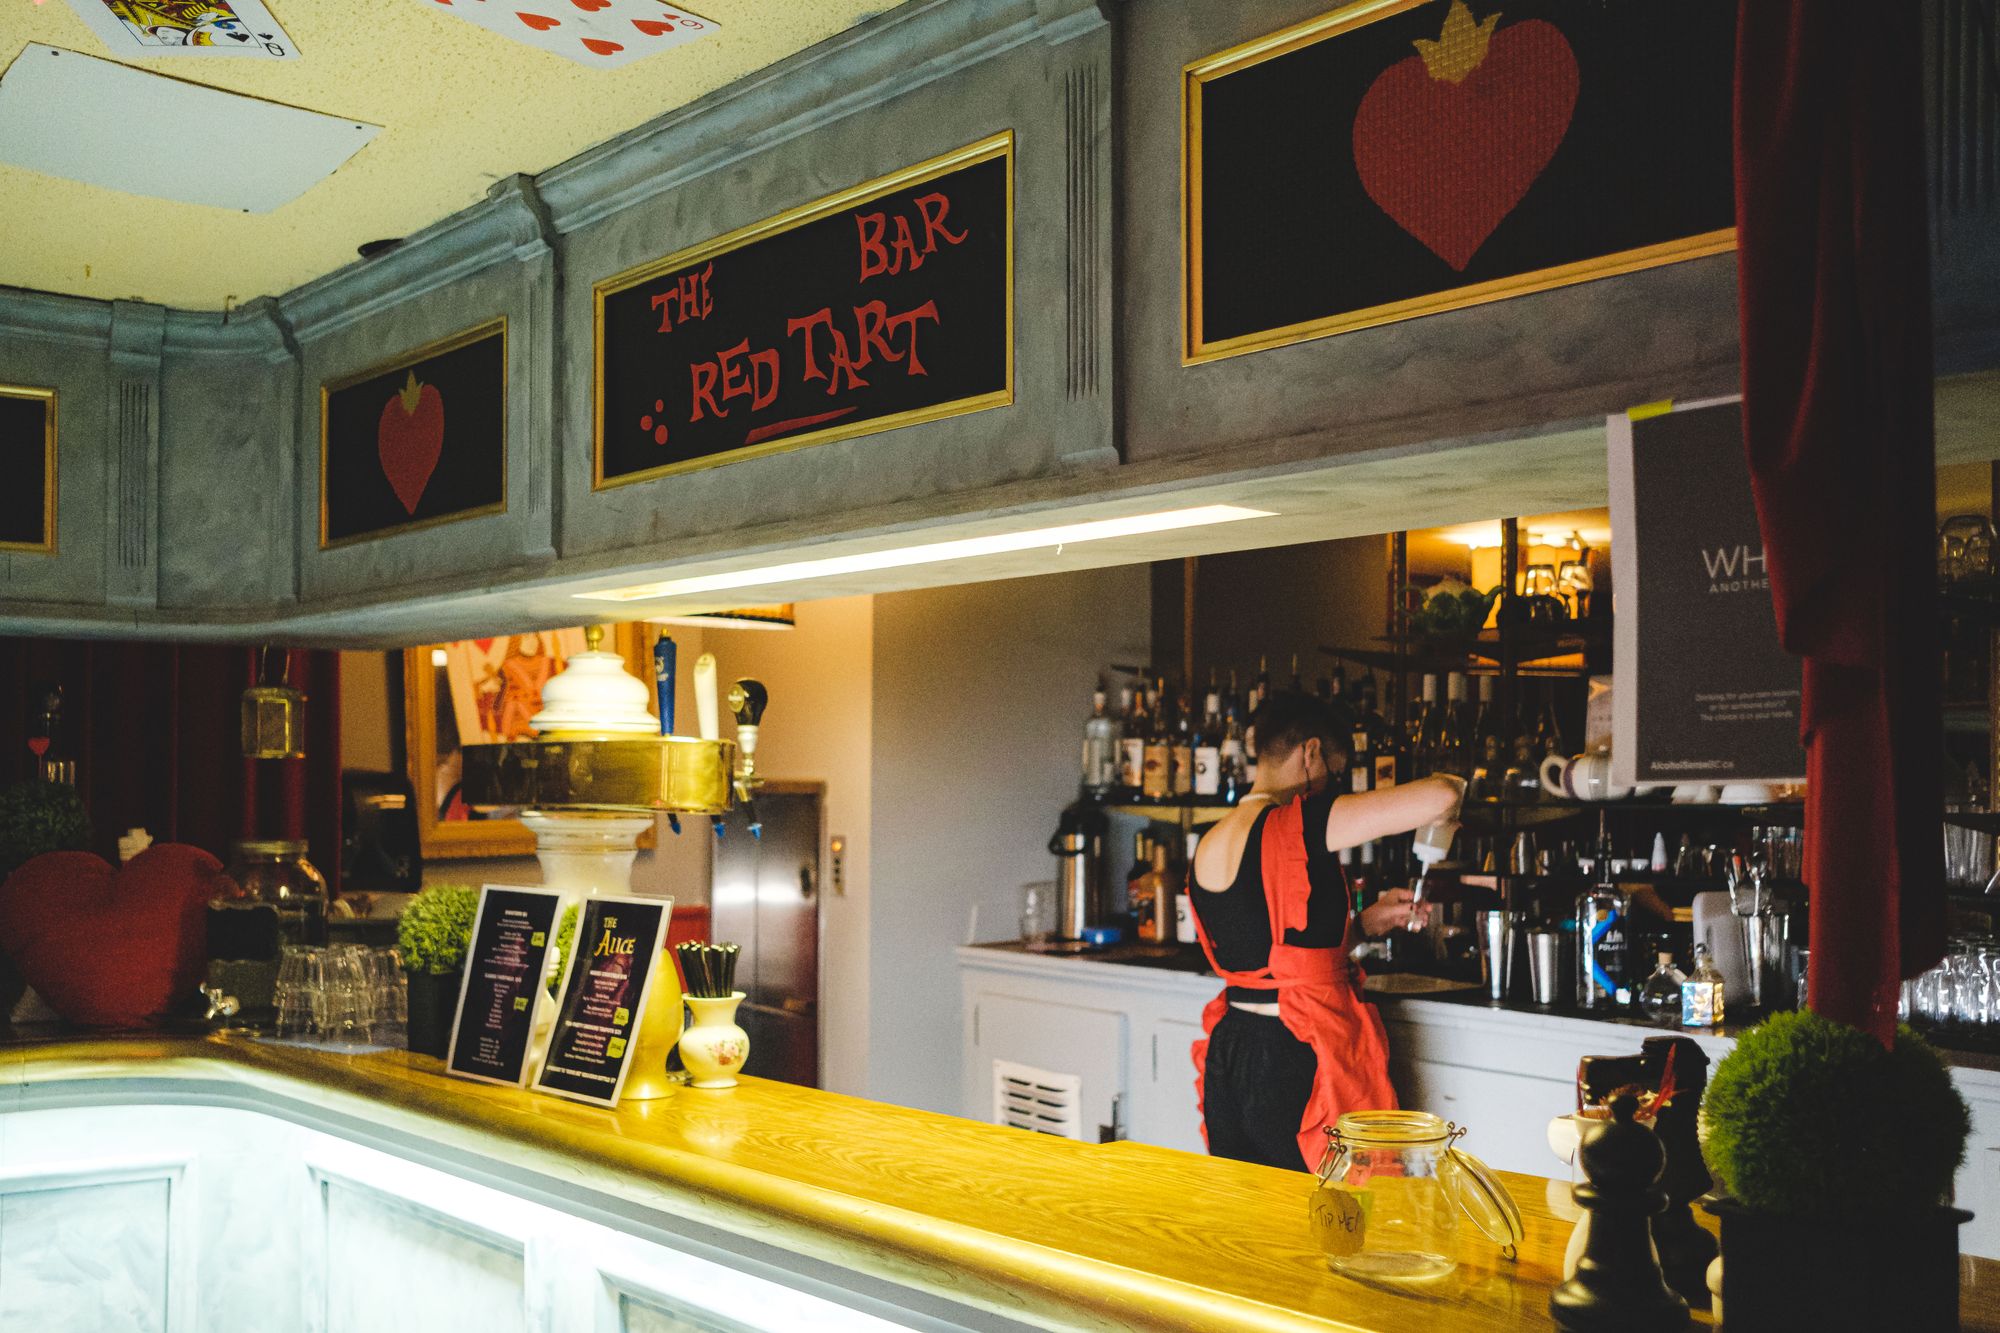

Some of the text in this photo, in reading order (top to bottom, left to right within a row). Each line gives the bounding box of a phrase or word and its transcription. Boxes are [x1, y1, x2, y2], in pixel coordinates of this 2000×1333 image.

[854, 192, 969, 284] BAR
[651, 261, 714, 333] THE
[690, 299, 940, 423] RED TART
[1702, 544, 1768, 579] WH
[1709, 578, 1769, 593] ANOTHE
[604, 917, 617, 928] THE
[1315, 1204, 1333, 1228] TIP
